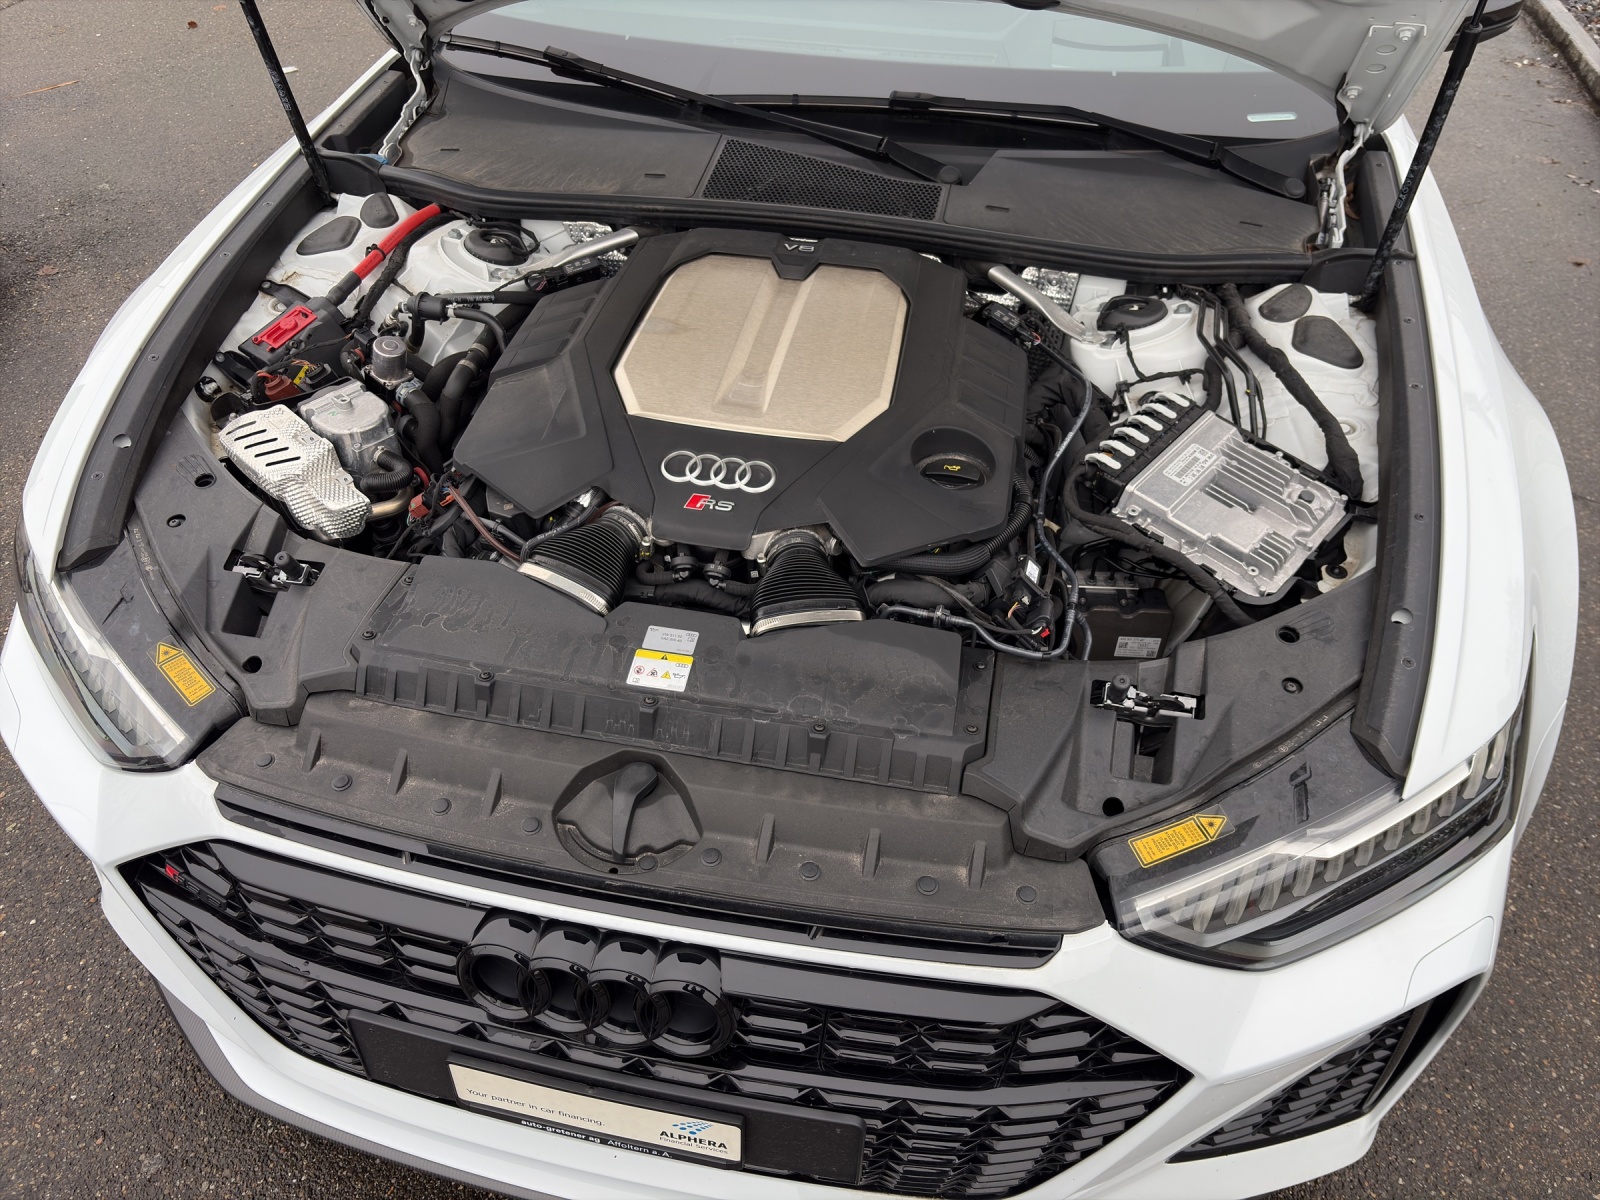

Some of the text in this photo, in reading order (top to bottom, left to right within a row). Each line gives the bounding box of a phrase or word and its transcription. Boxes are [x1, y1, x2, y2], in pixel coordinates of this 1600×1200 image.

[784, 243, 814, 252] V8
[688, 495, 735, 511] RS
[466, 1088, 488, 1098] Your
[491, 1094, 526, 1108] partner
[558, 1110, 605, 1126] financing.
[520, 1119, 587, 1140] auto-gretener
[588, 1135, 601, 1144] ag
[607, 1139, 650, 1154] Affoltern
[660, 1130, 728, 1150] ALPHERA
[660, 1136, 728, 1154] Financial Services
